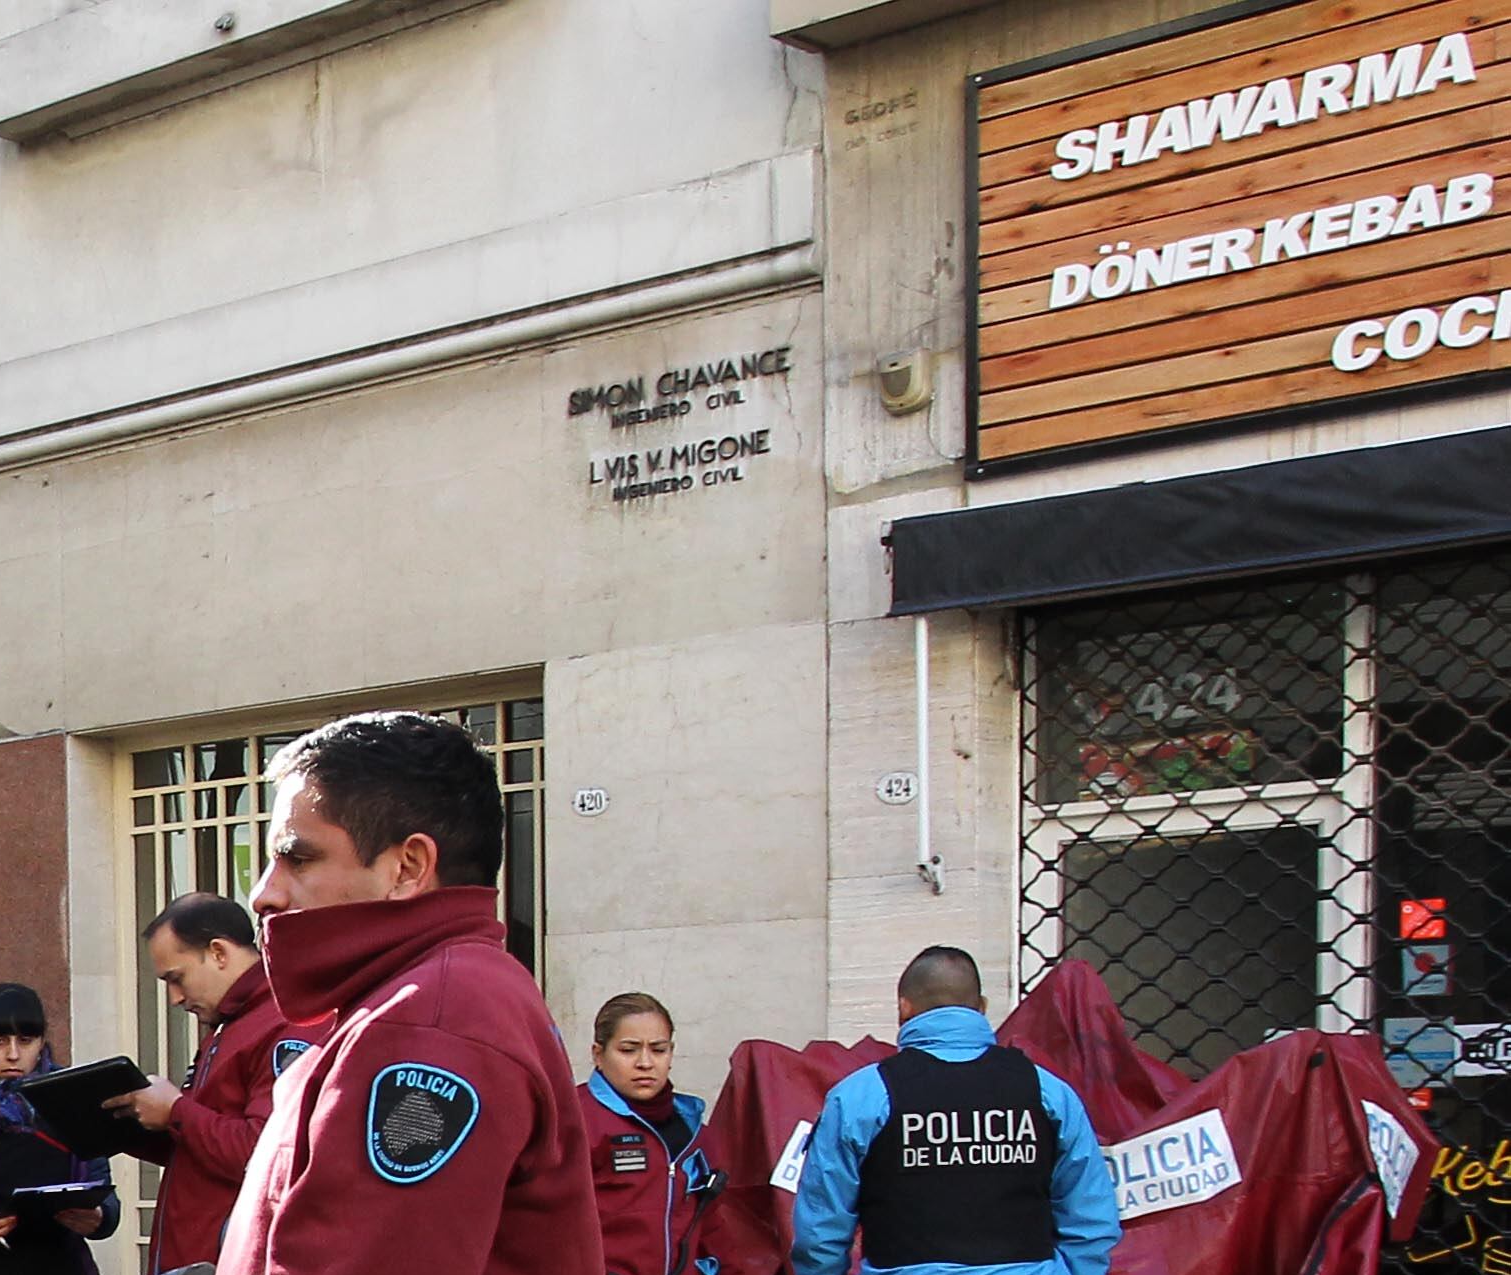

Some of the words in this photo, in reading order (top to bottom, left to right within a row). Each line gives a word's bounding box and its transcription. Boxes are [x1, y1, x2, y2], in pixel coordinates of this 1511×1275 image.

[1050, 32, 1476, 181] SHAWARMA
[1049, 226, 1257, 310] DÖNER
[1259, 172, 1494, 265] KEBAB
[569, 376, 646, 416] SIMON
[656, 346, 792, 397] CHAVANCE
[610, 400, 691, 429] INGENIERO
[706, 389, 746, 408] CIVIL
[669, 429, 770, 469] MIGONE
[612, 474, 693, 501] INGENIERO
[703, 465, 744, 485] CIVIL
[1135, 667, 1241, 721] 424
[579, 792, 602, 812] 420
[886, 778, 911, 797] 424
[395, 1070, 459, 1102] POLICIA
[902, 1109, 1037, 1145] POLICIA
[903, 1147, 930, 1167] DE
[936, 1146, 964, 1165] LA
[969, 1144, 1037, 1165] CIUDAD
[1103, 1127, 1222, 1189] OLICIA
[1144, 1162, 1230, 1203] CIUDAD
